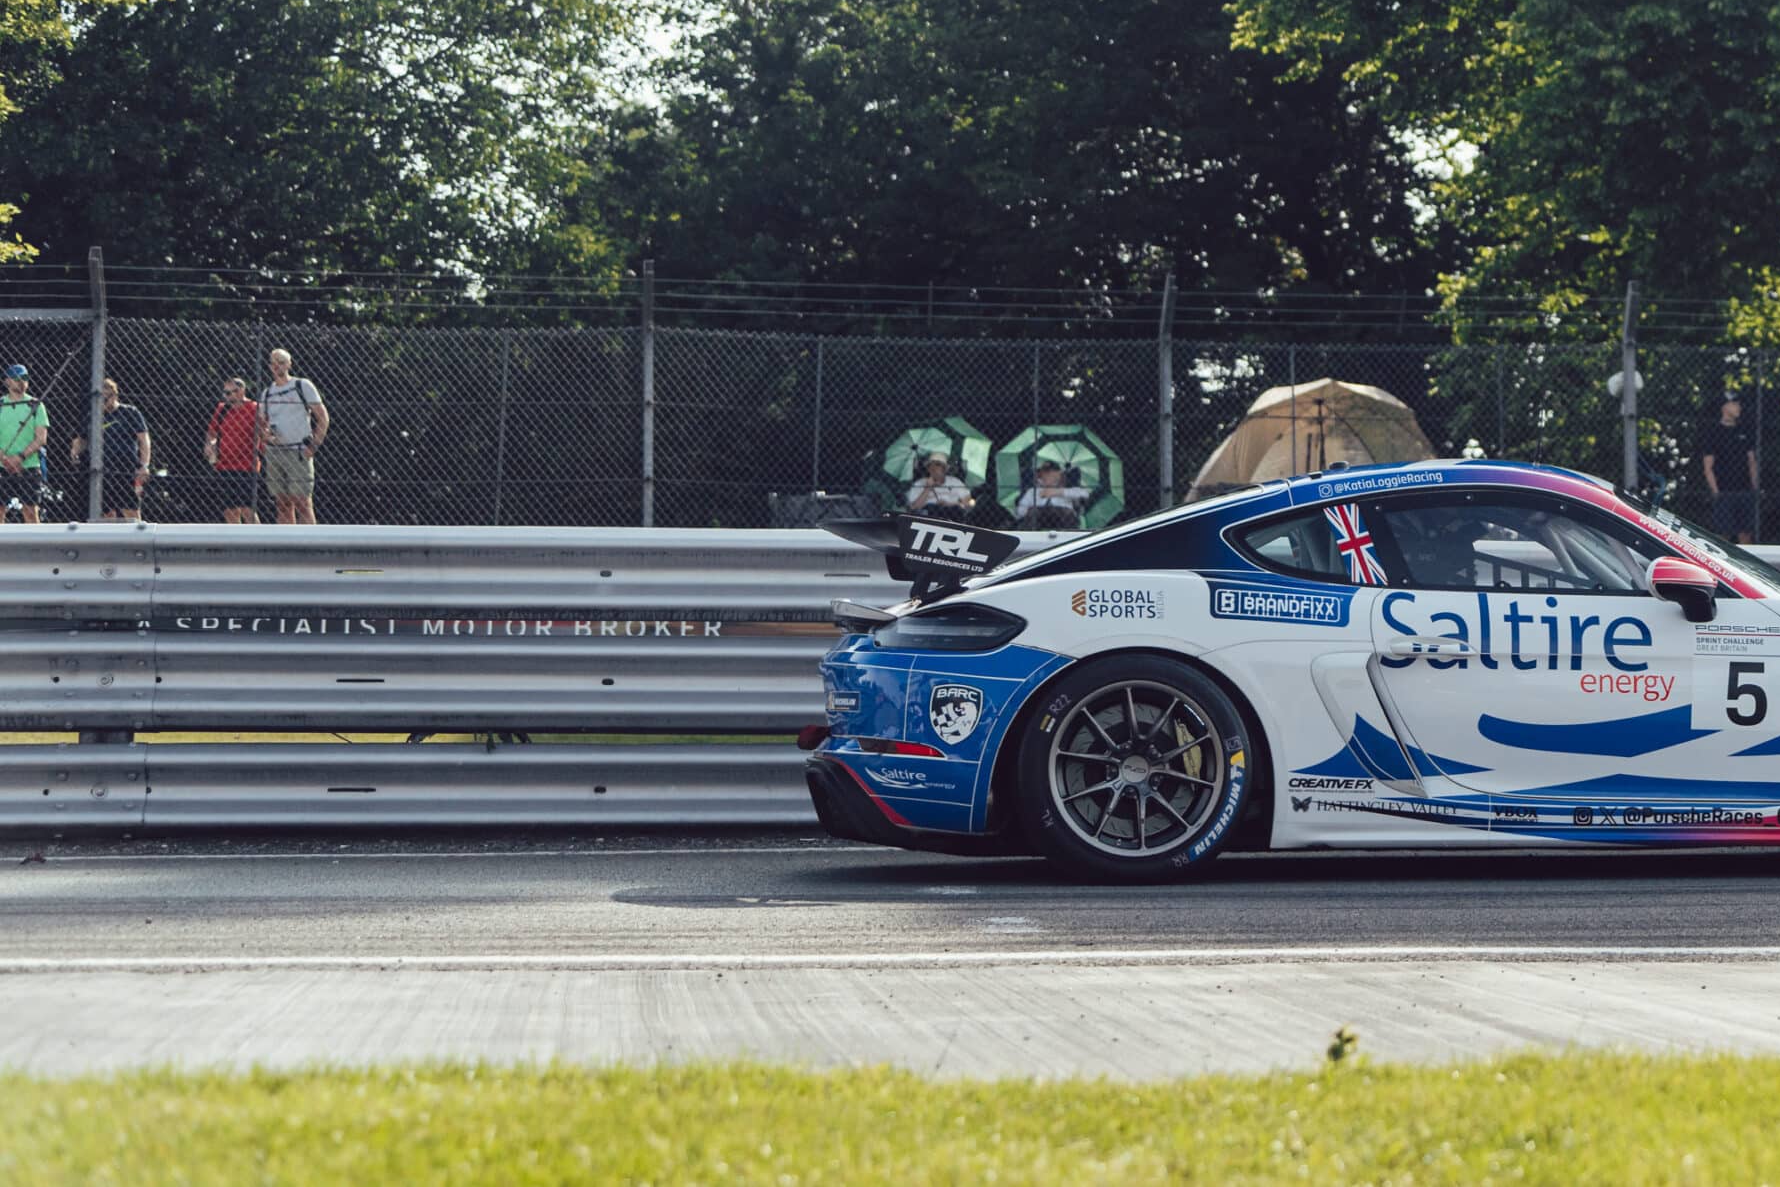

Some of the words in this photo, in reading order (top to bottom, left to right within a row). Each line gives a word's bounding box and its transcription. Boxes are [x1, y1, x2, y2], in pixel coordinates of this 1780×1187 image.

[1334, 472, 1443, 493] @KatiaLoggieRacing
[910, 522, 989, 563] TRL
[1639, 515, 1737, 583] www.porsche.co.uk
[905, 552, 932, 564] TRAILER
[932, 557, 970, 571] RESOURCES
[971, 564, 984, 573] LTD
[1088, 589, 1155, 604] GLOBAL
[1243, 595, 1336, 617] BRANDFIXX
[1088, 604, 1156, 619] SPORTS
[574, 619, 722, 637] BROKER
[1380, 591, 1653, 672] Saltire
[1695, 624, 1780, 633] PORSCHE
[936, 687, 978, 702] BARC
[1580, 674, 1676, 702] energy
[1726, 661, 1768, 727] 5
[881, 767, 927, 781] Saltire
[1288, 777, 1355, 790] CREATIVE
[1355, 779, 1375, 790] FX
[1195, 783, 1241, 855] MICHELIN
[1407, 802, 1458, 815] VALLEY
